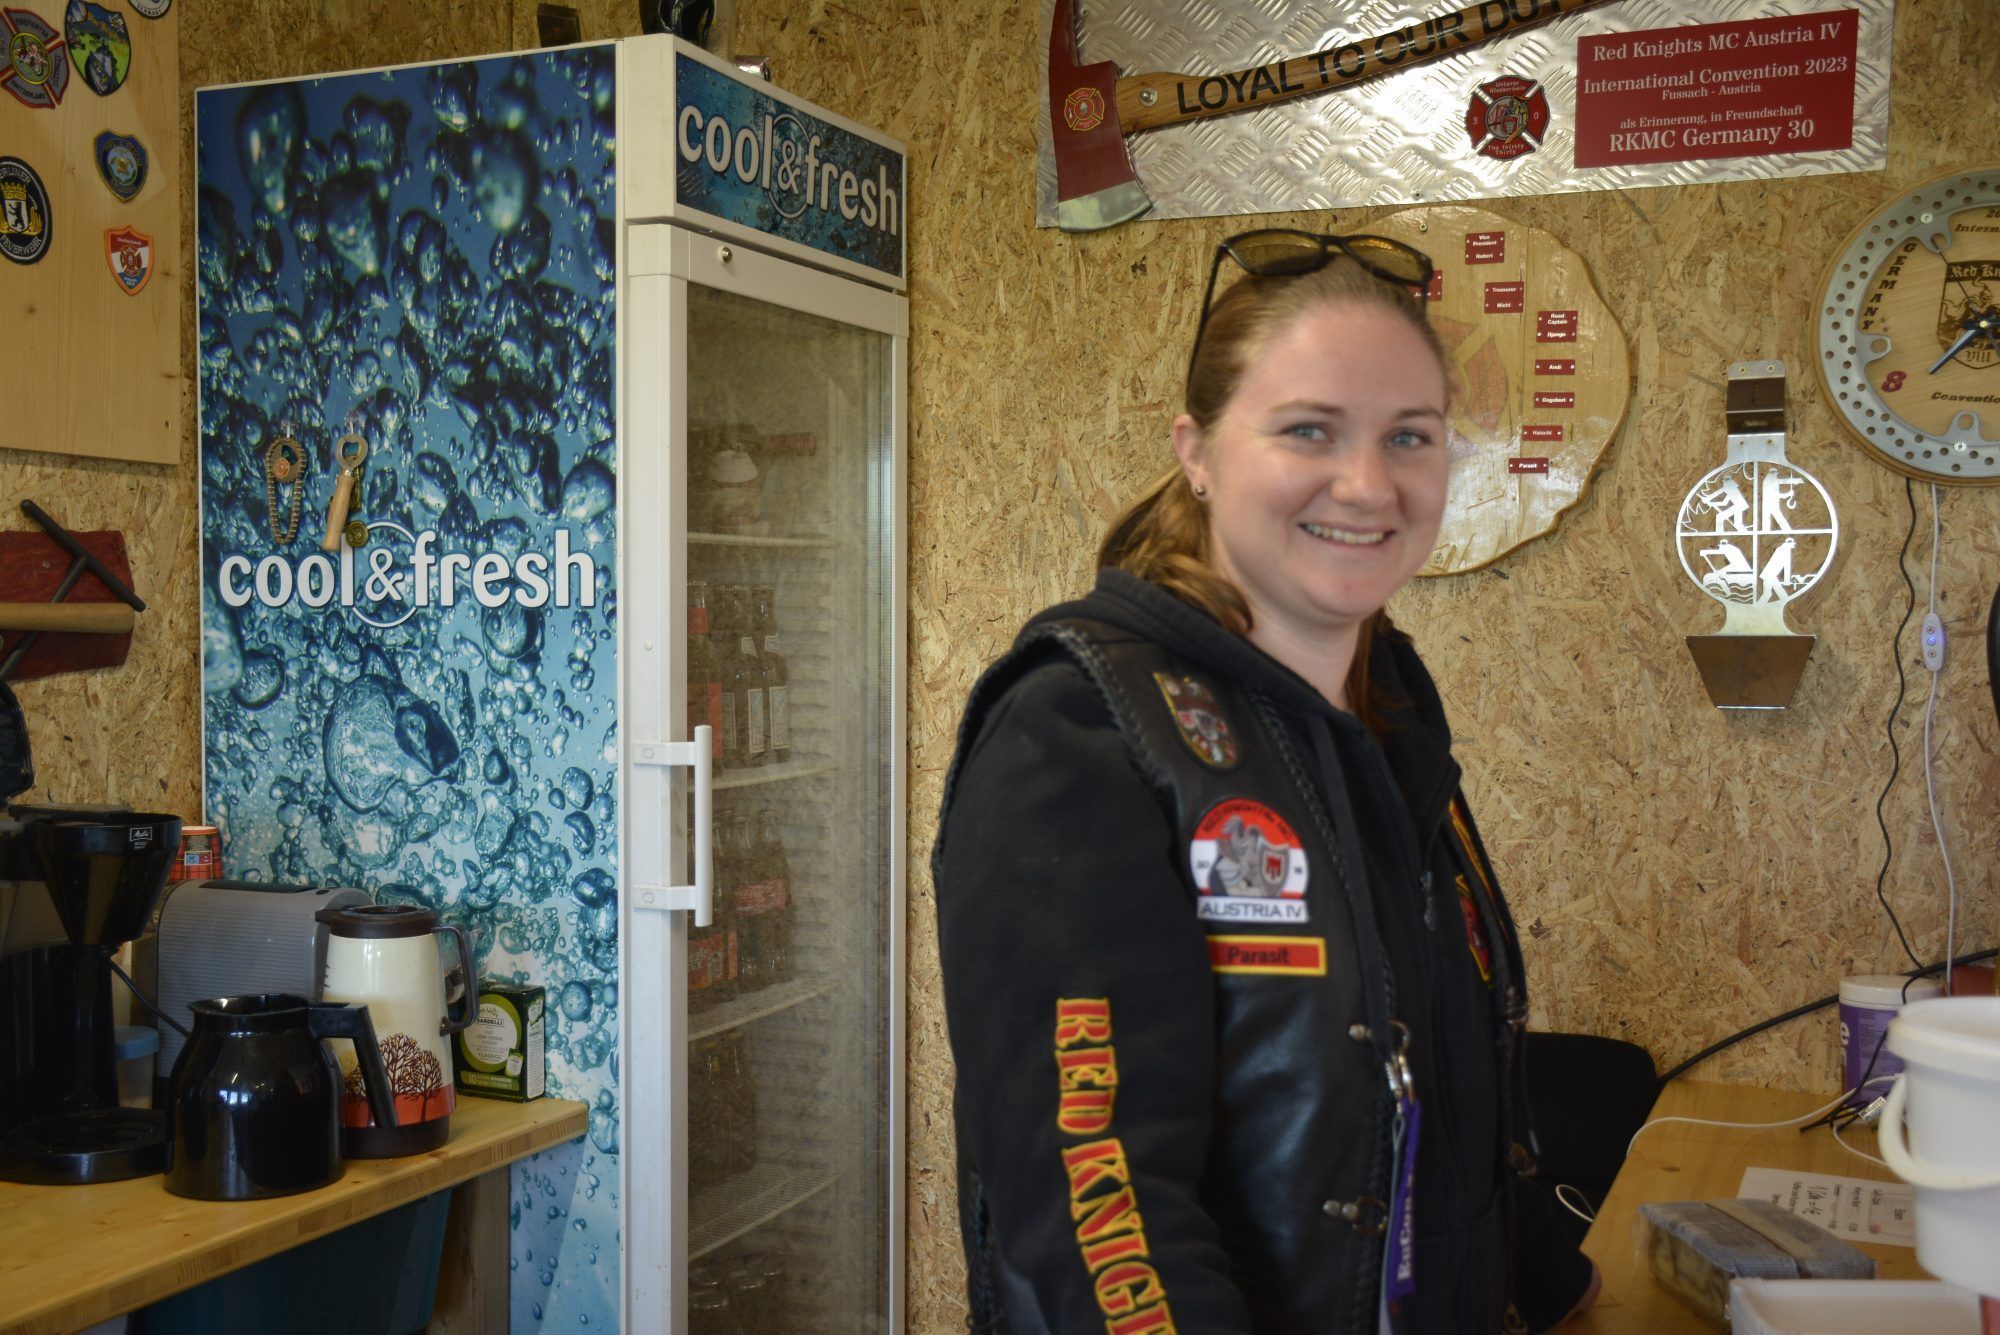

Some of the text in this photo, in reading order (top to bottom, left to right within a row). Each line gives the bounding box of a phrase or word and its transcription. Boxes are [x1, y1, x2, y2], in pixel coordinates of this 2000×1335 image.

[1593, 22, 1842, 62] Red Knights MC Austria IV
[1176, 0, 1597, 116] LOYAL TO OUR DU
[1583, 56, 1848, 95] International Convention 2023
[1661, 86, 1708, 101] Fussach
[1718, 82, 1761, 95] Austria
[1619, 103, 1804, 129] als Erinnerung, in Freundschaft
[1609, 118, 1815, 153] RKMC Germany 30
[678, 105, 897, 236] cool&fresh
[1954, 223, 2000, 233] Intern
[0, 234, 42, 256] FEUERWEHR
[1862, 243, 1917, 330] GERMANY
[1950, 265, 1977, 278] Red
[1880, 370, 1907, 393] 8
[218, 529, 595, 607] cool&fresh
[1202, 902, 1302, 918] AUSTRIA IV
[1227, 947, 1290, 965] Parasit
[1055, 998, 1119, 1134] RED
